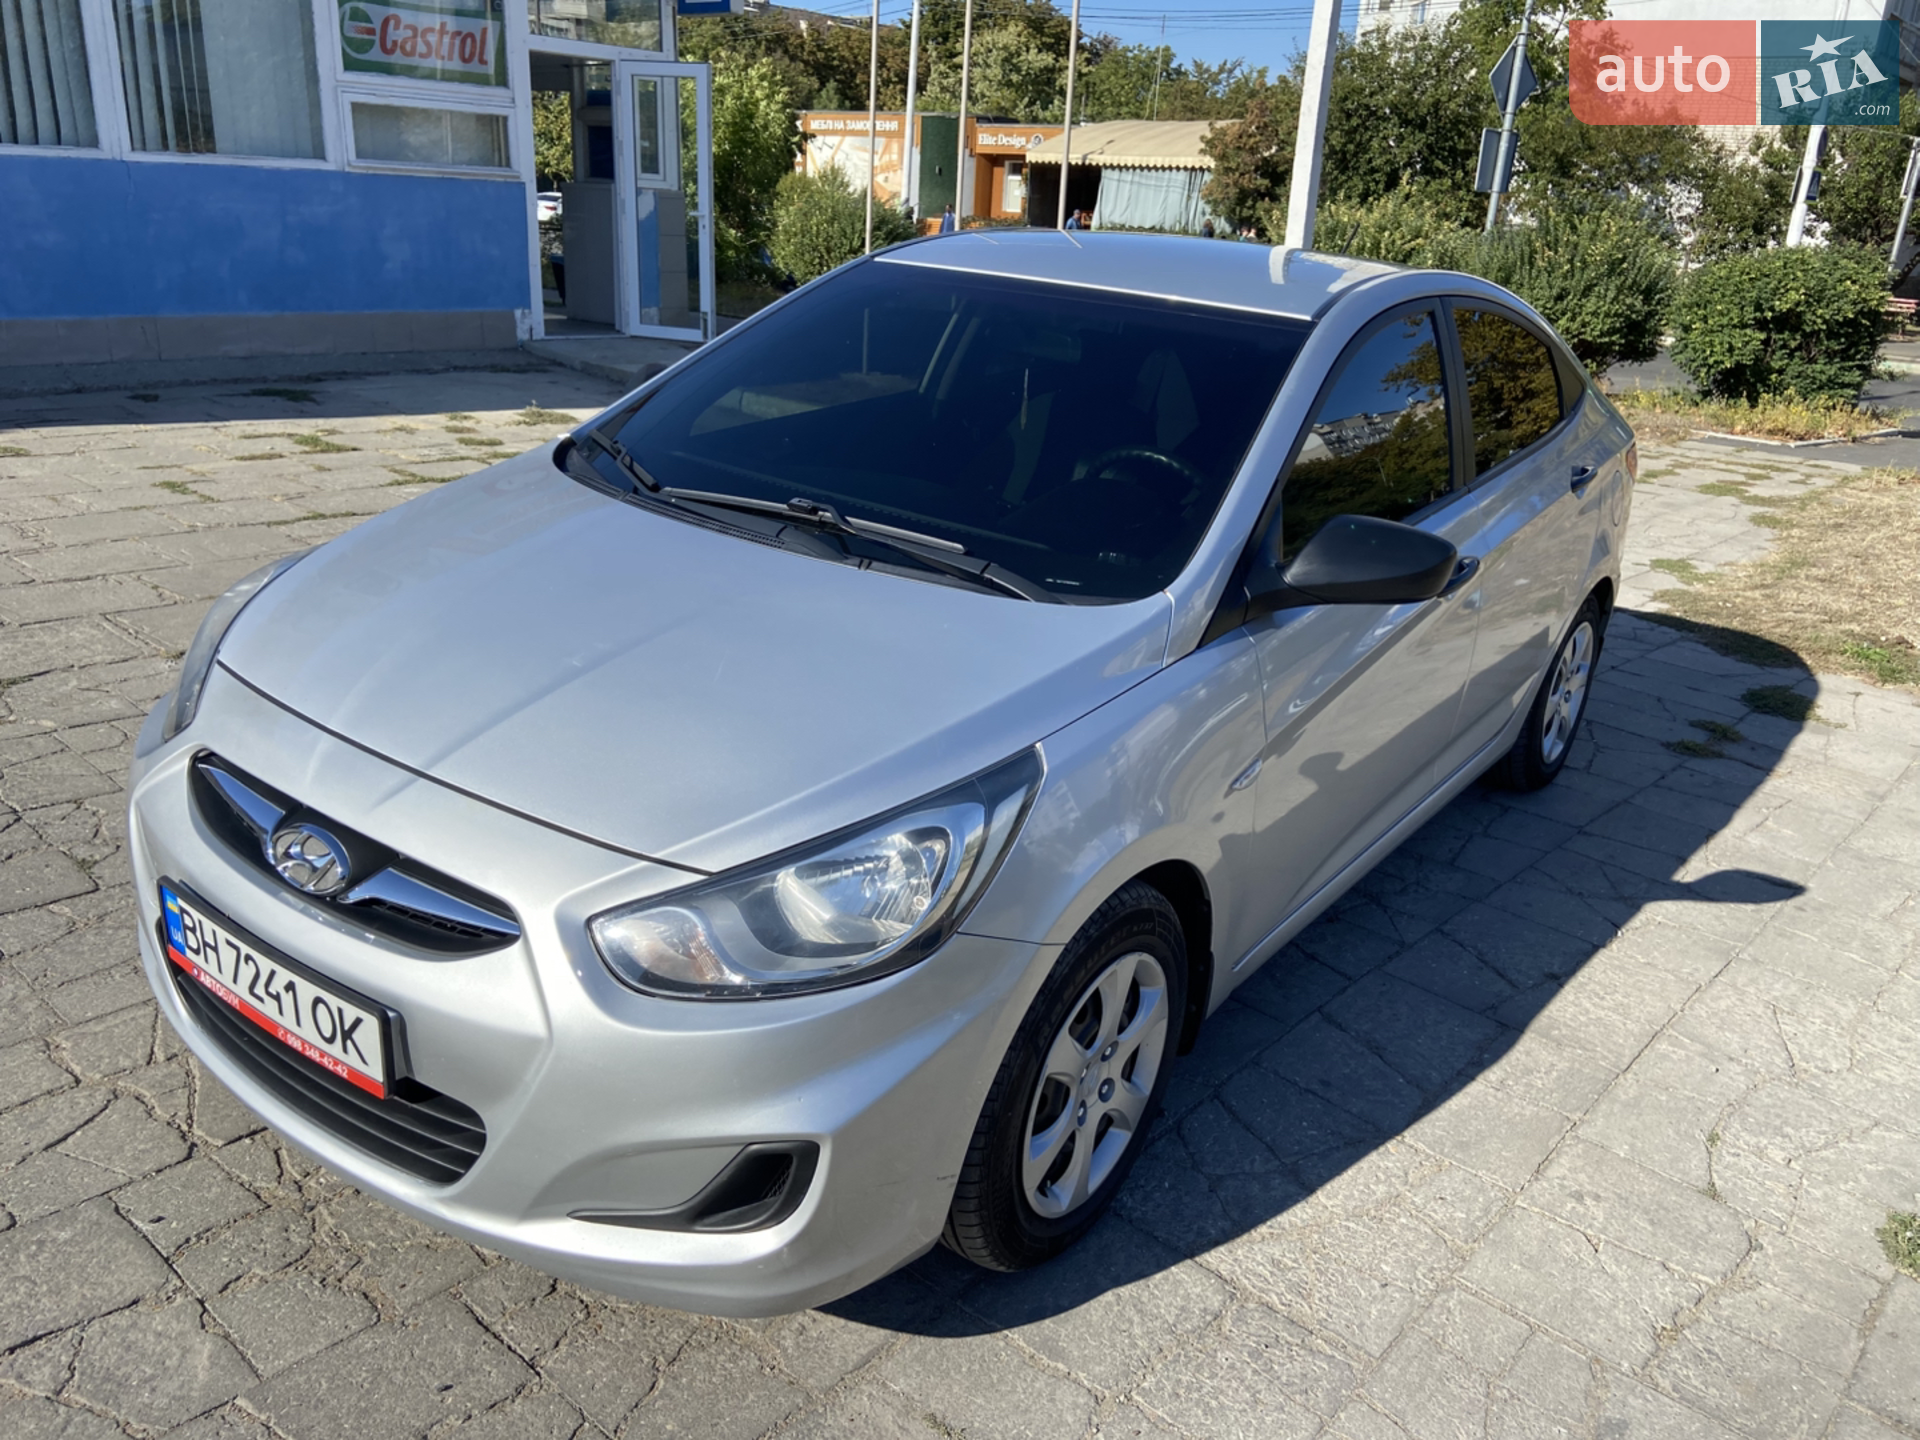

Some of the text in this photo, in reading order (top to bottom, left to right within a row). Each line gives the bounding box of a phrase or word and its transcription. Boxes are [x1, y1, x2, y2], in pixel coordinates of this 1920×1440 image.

[379, 13, 489, 66] Castrol
[845, 120, 899, 131] ЗАМОЕННЯ
[978, 133, 1026, 149] Elite Design
[170, 926, 186, 946] UA
[180, 904, 369, 1067] BH 7241 OK
